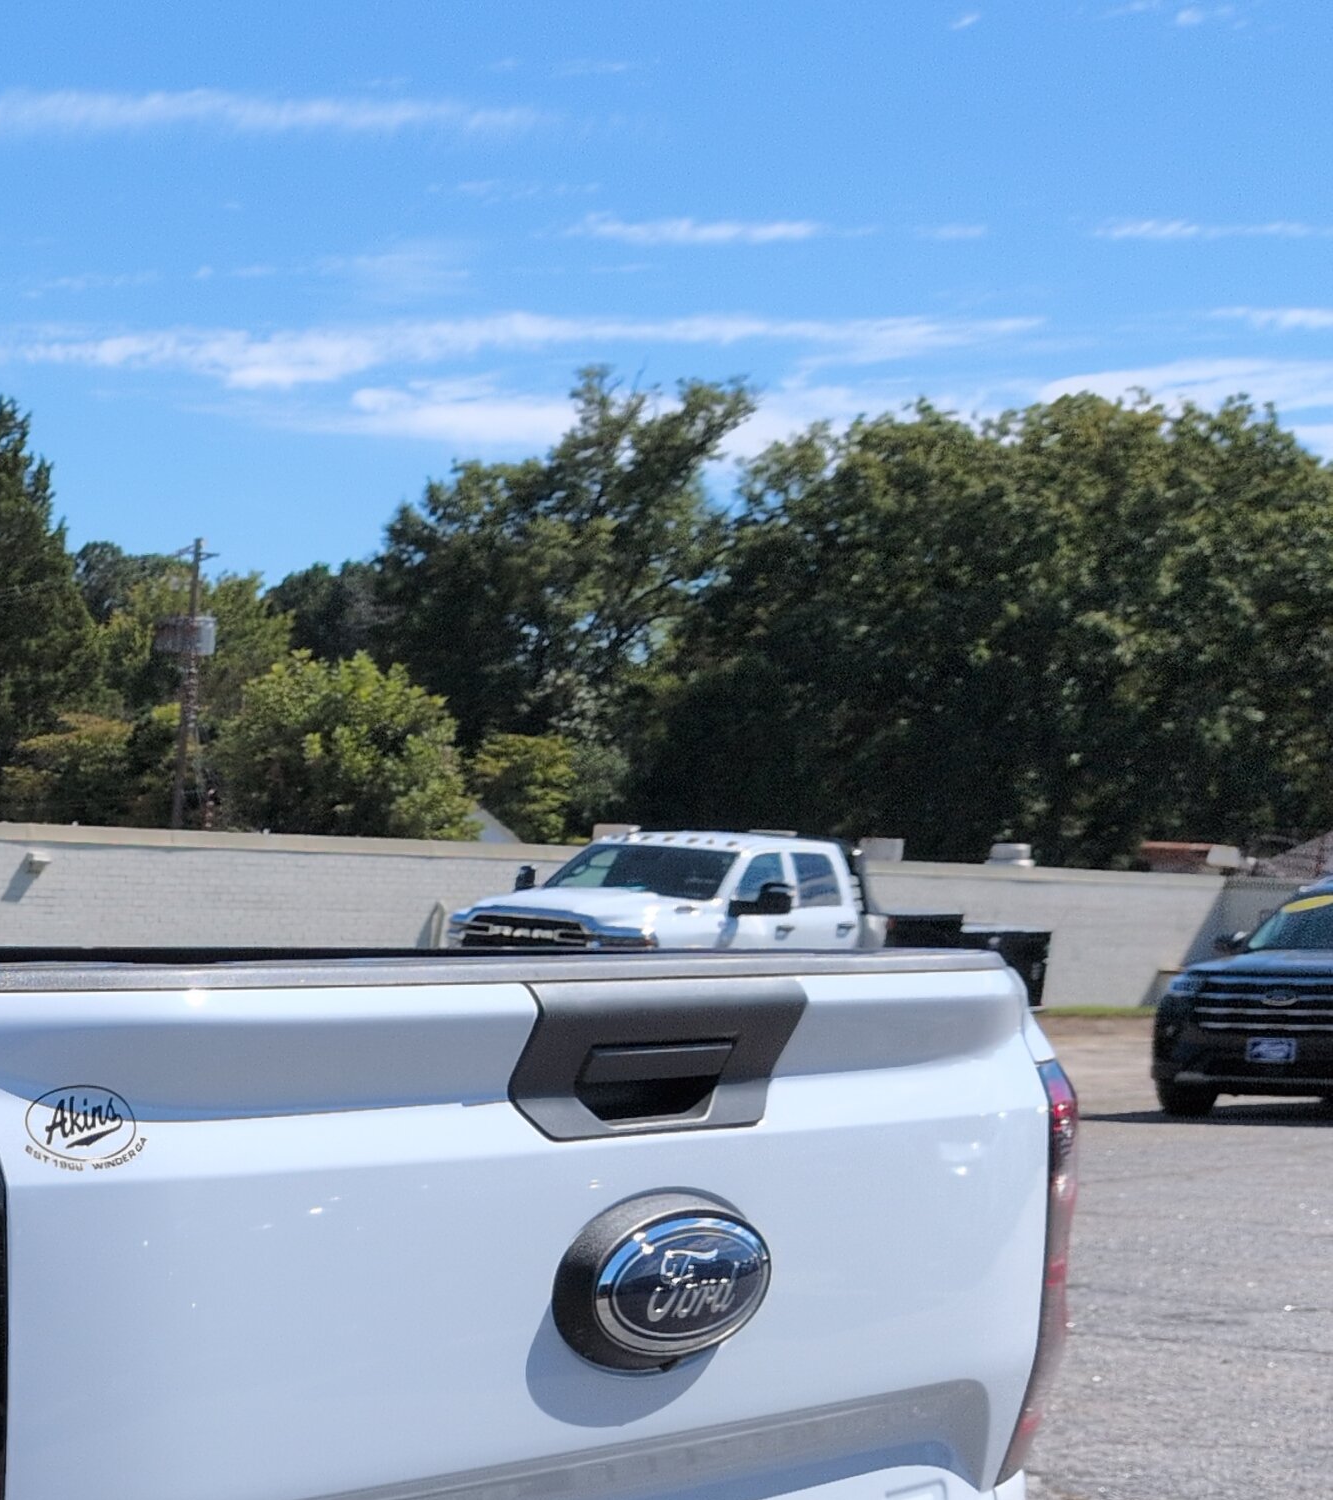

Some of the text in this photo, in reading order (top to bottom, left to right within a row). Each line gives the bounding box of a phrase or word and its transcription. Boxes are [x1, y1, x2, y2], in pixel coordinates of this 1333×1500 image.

[45, 1096, 123, 1148] Akins
[92, 1149, 136, 1170] WINDER
[647, 1249, 739, 1322] Ford
